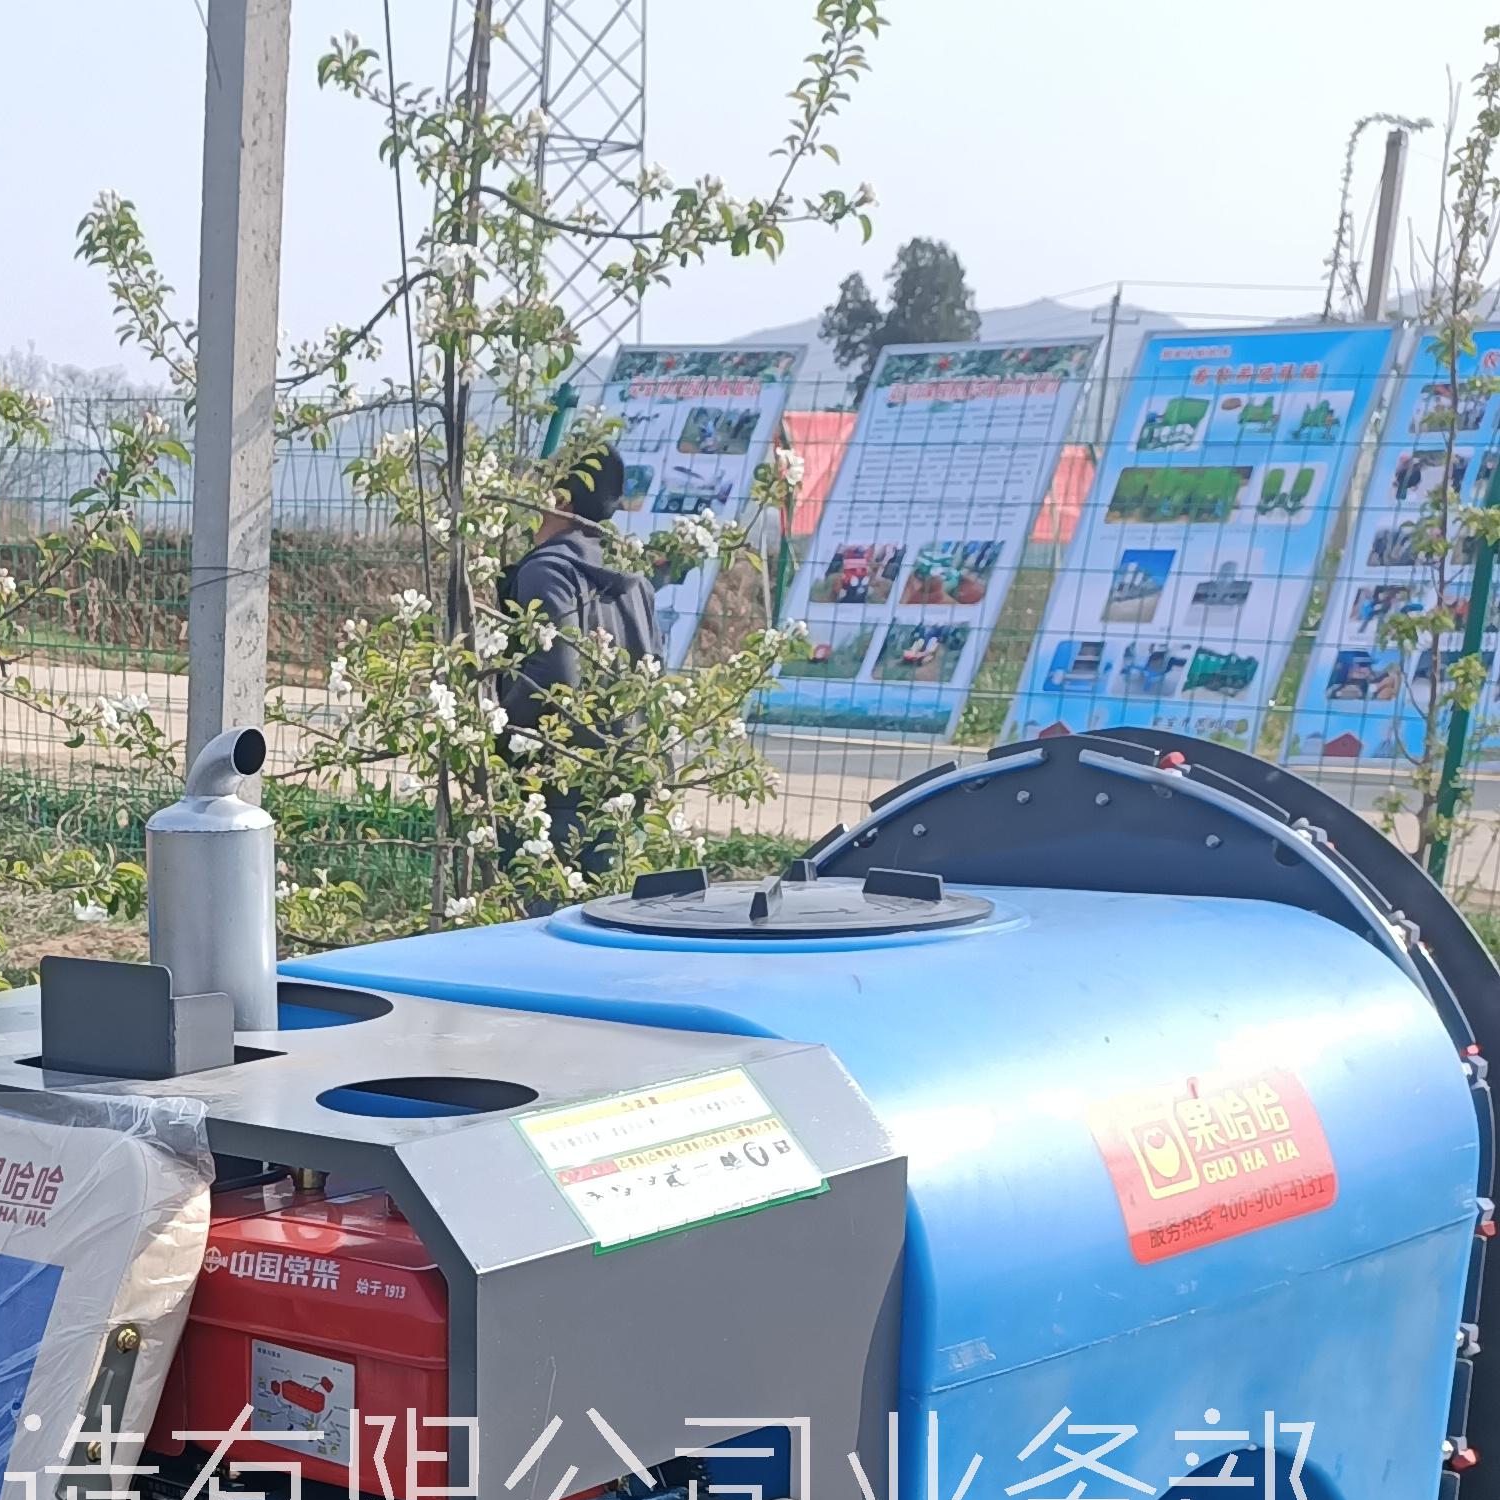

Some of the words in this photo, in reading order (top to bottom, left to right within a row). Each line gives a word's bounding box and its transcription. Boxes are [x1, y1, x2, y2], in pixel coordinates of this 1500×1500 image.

[1176, 1080, 1291, 1153] 果哈哈
[1202, 1157, 1239, 1184] GUO
[1240, 1150, 1269, 1174] HA
[1272, 1138, 1301, 1163] HA
[25, 1210, 47, 1228] HA
[1219, 1177, 1325, 1222] 400-900-4131
[229, 1250, 341, 1291] 中国常柴
[355, 1277, 383, 1296] 始于
[384, 1284, 407, 1299] 1913
